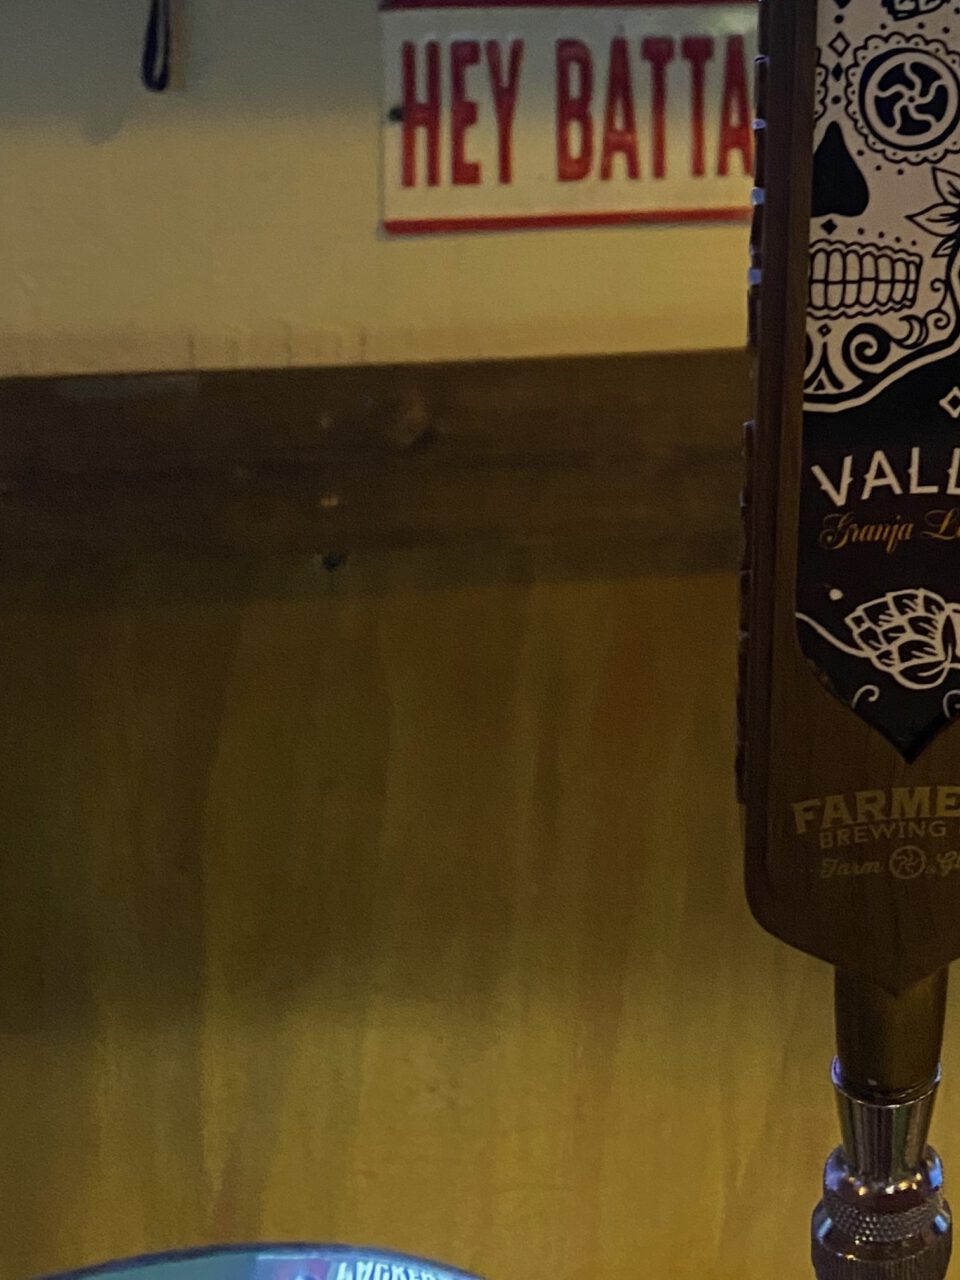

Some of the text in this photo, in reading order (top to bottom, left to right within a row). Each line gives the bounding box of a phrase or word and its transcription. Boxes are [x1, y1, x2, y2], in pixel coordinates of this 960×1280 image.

[400, 38, 525, 188] HEY
[553, 33, 756, 183] BATTA
[819, 510, 915, 554] Granja
[818, 819, 948, 850] BREWING
